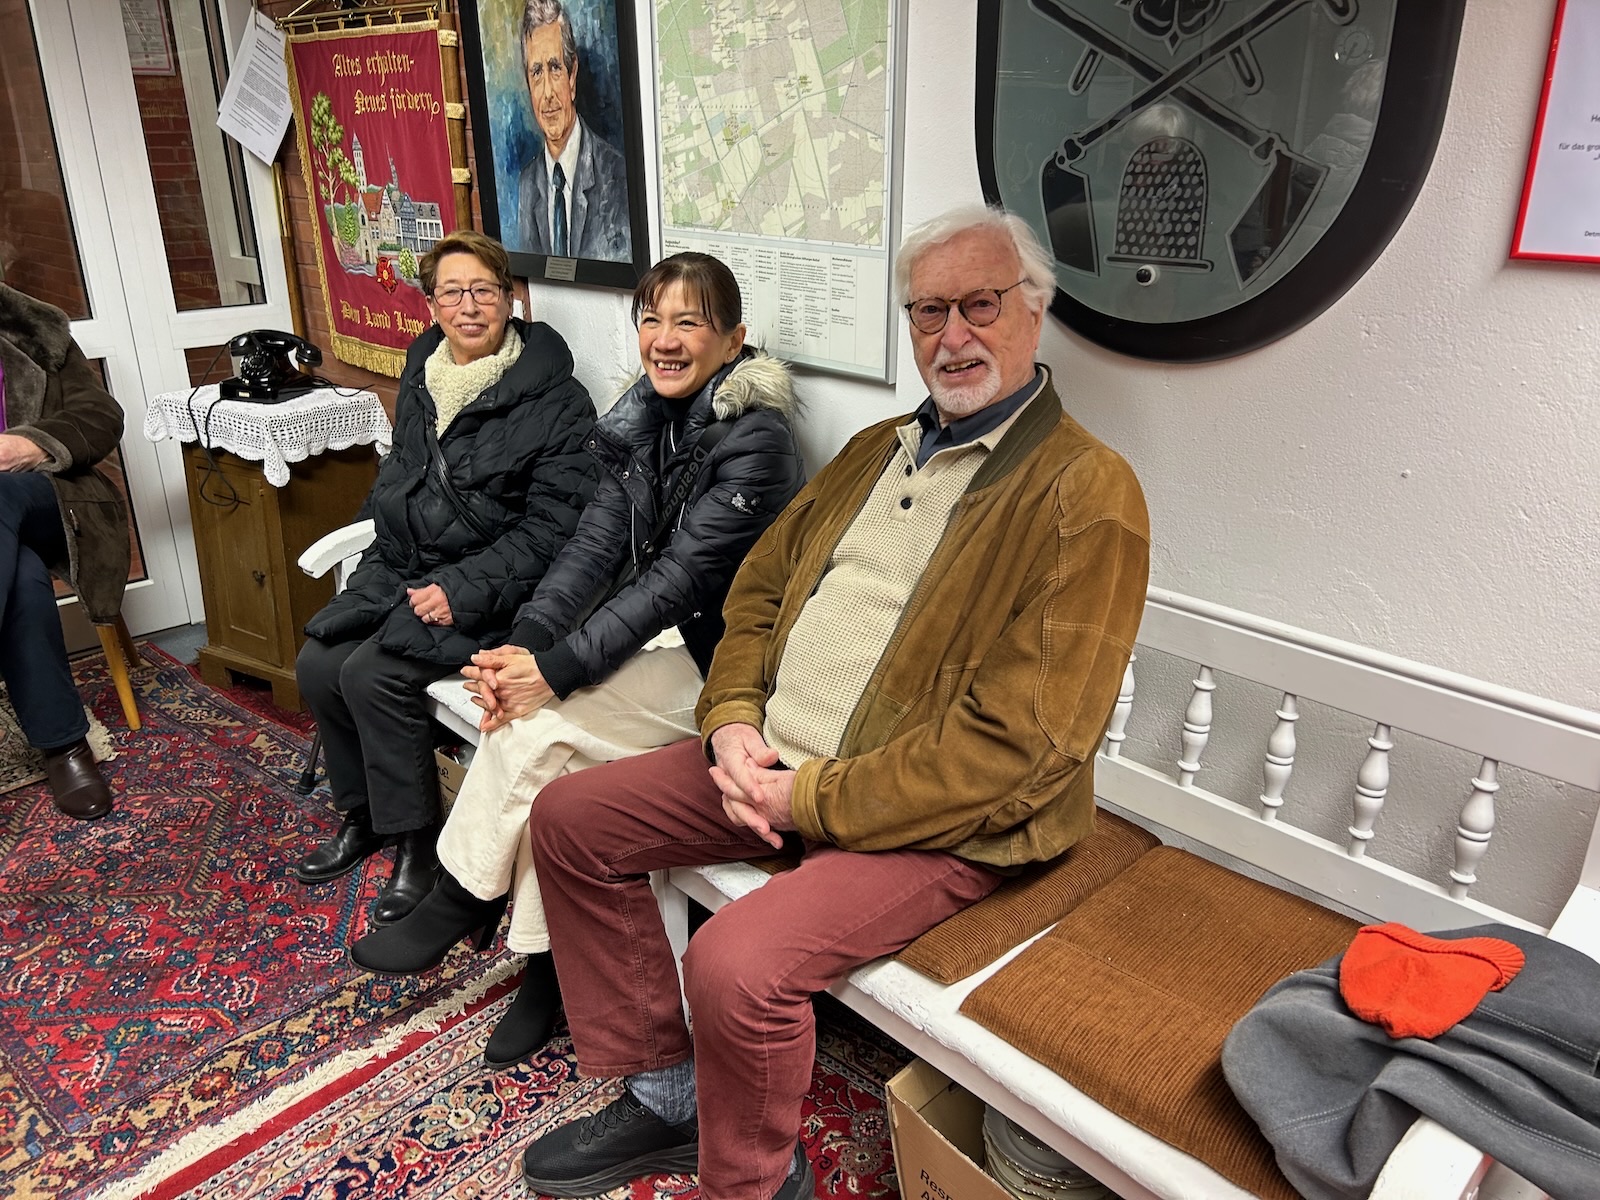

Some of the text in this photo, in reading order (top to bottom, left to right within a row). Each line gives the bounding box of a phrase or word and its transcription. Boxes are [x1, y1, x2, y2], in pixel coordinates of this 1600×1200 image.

[332, 49, 414, 87] Altes erhalten-
[354, 87, 440, 122] Neues fördern
[1559, 142, 1570, 150] für
[362, 305, 391, 329] Land
[394, 310, 425, 338] Lippe
